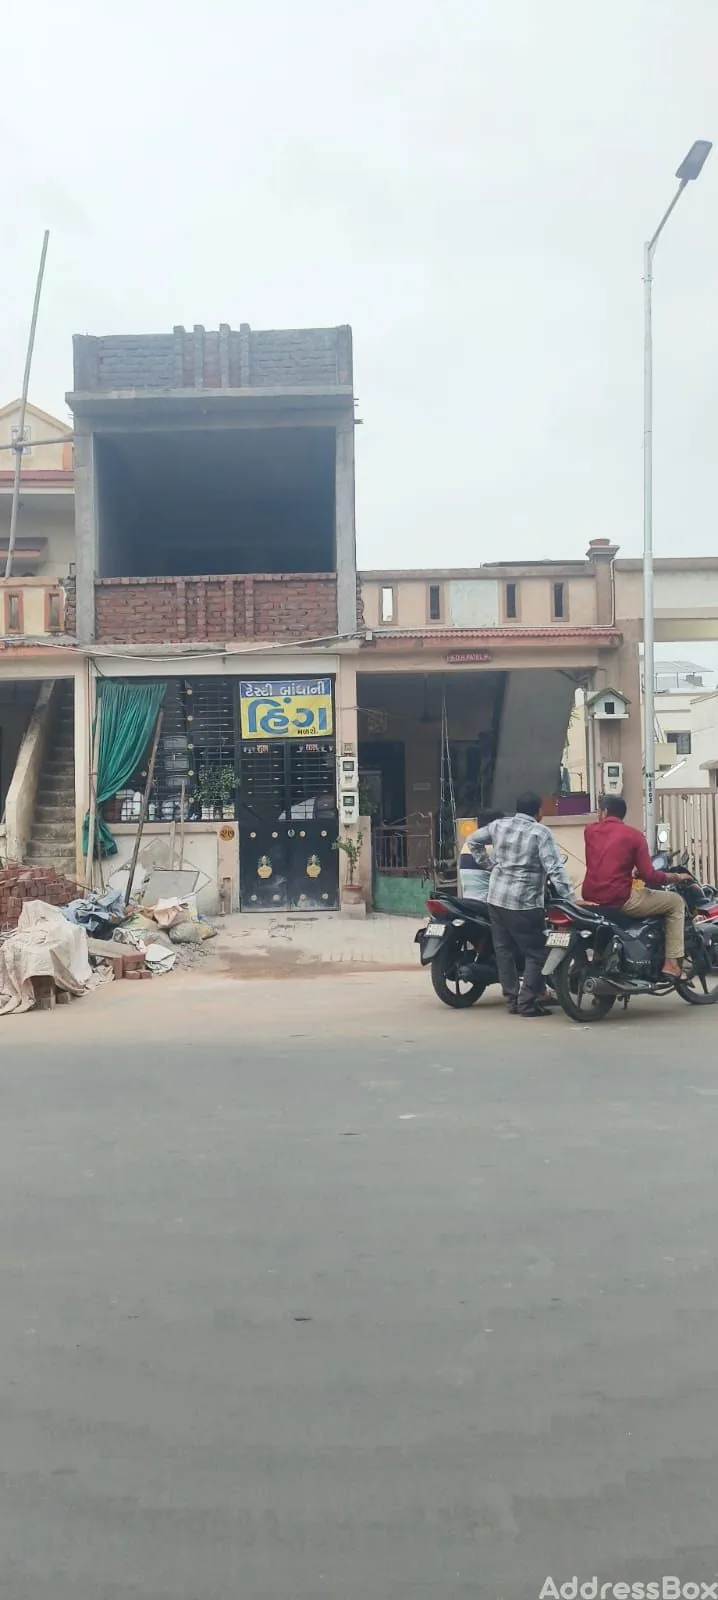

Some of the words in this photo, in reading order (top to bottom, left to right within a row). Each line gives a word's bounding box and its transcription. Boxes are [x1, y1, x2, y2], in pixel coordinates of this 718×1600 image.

[245, 683, 272, 697] ટેસ્ટી
[279, 681, 325, 696] બાંધાની
[248, 697, 327, 735] હિંગ
